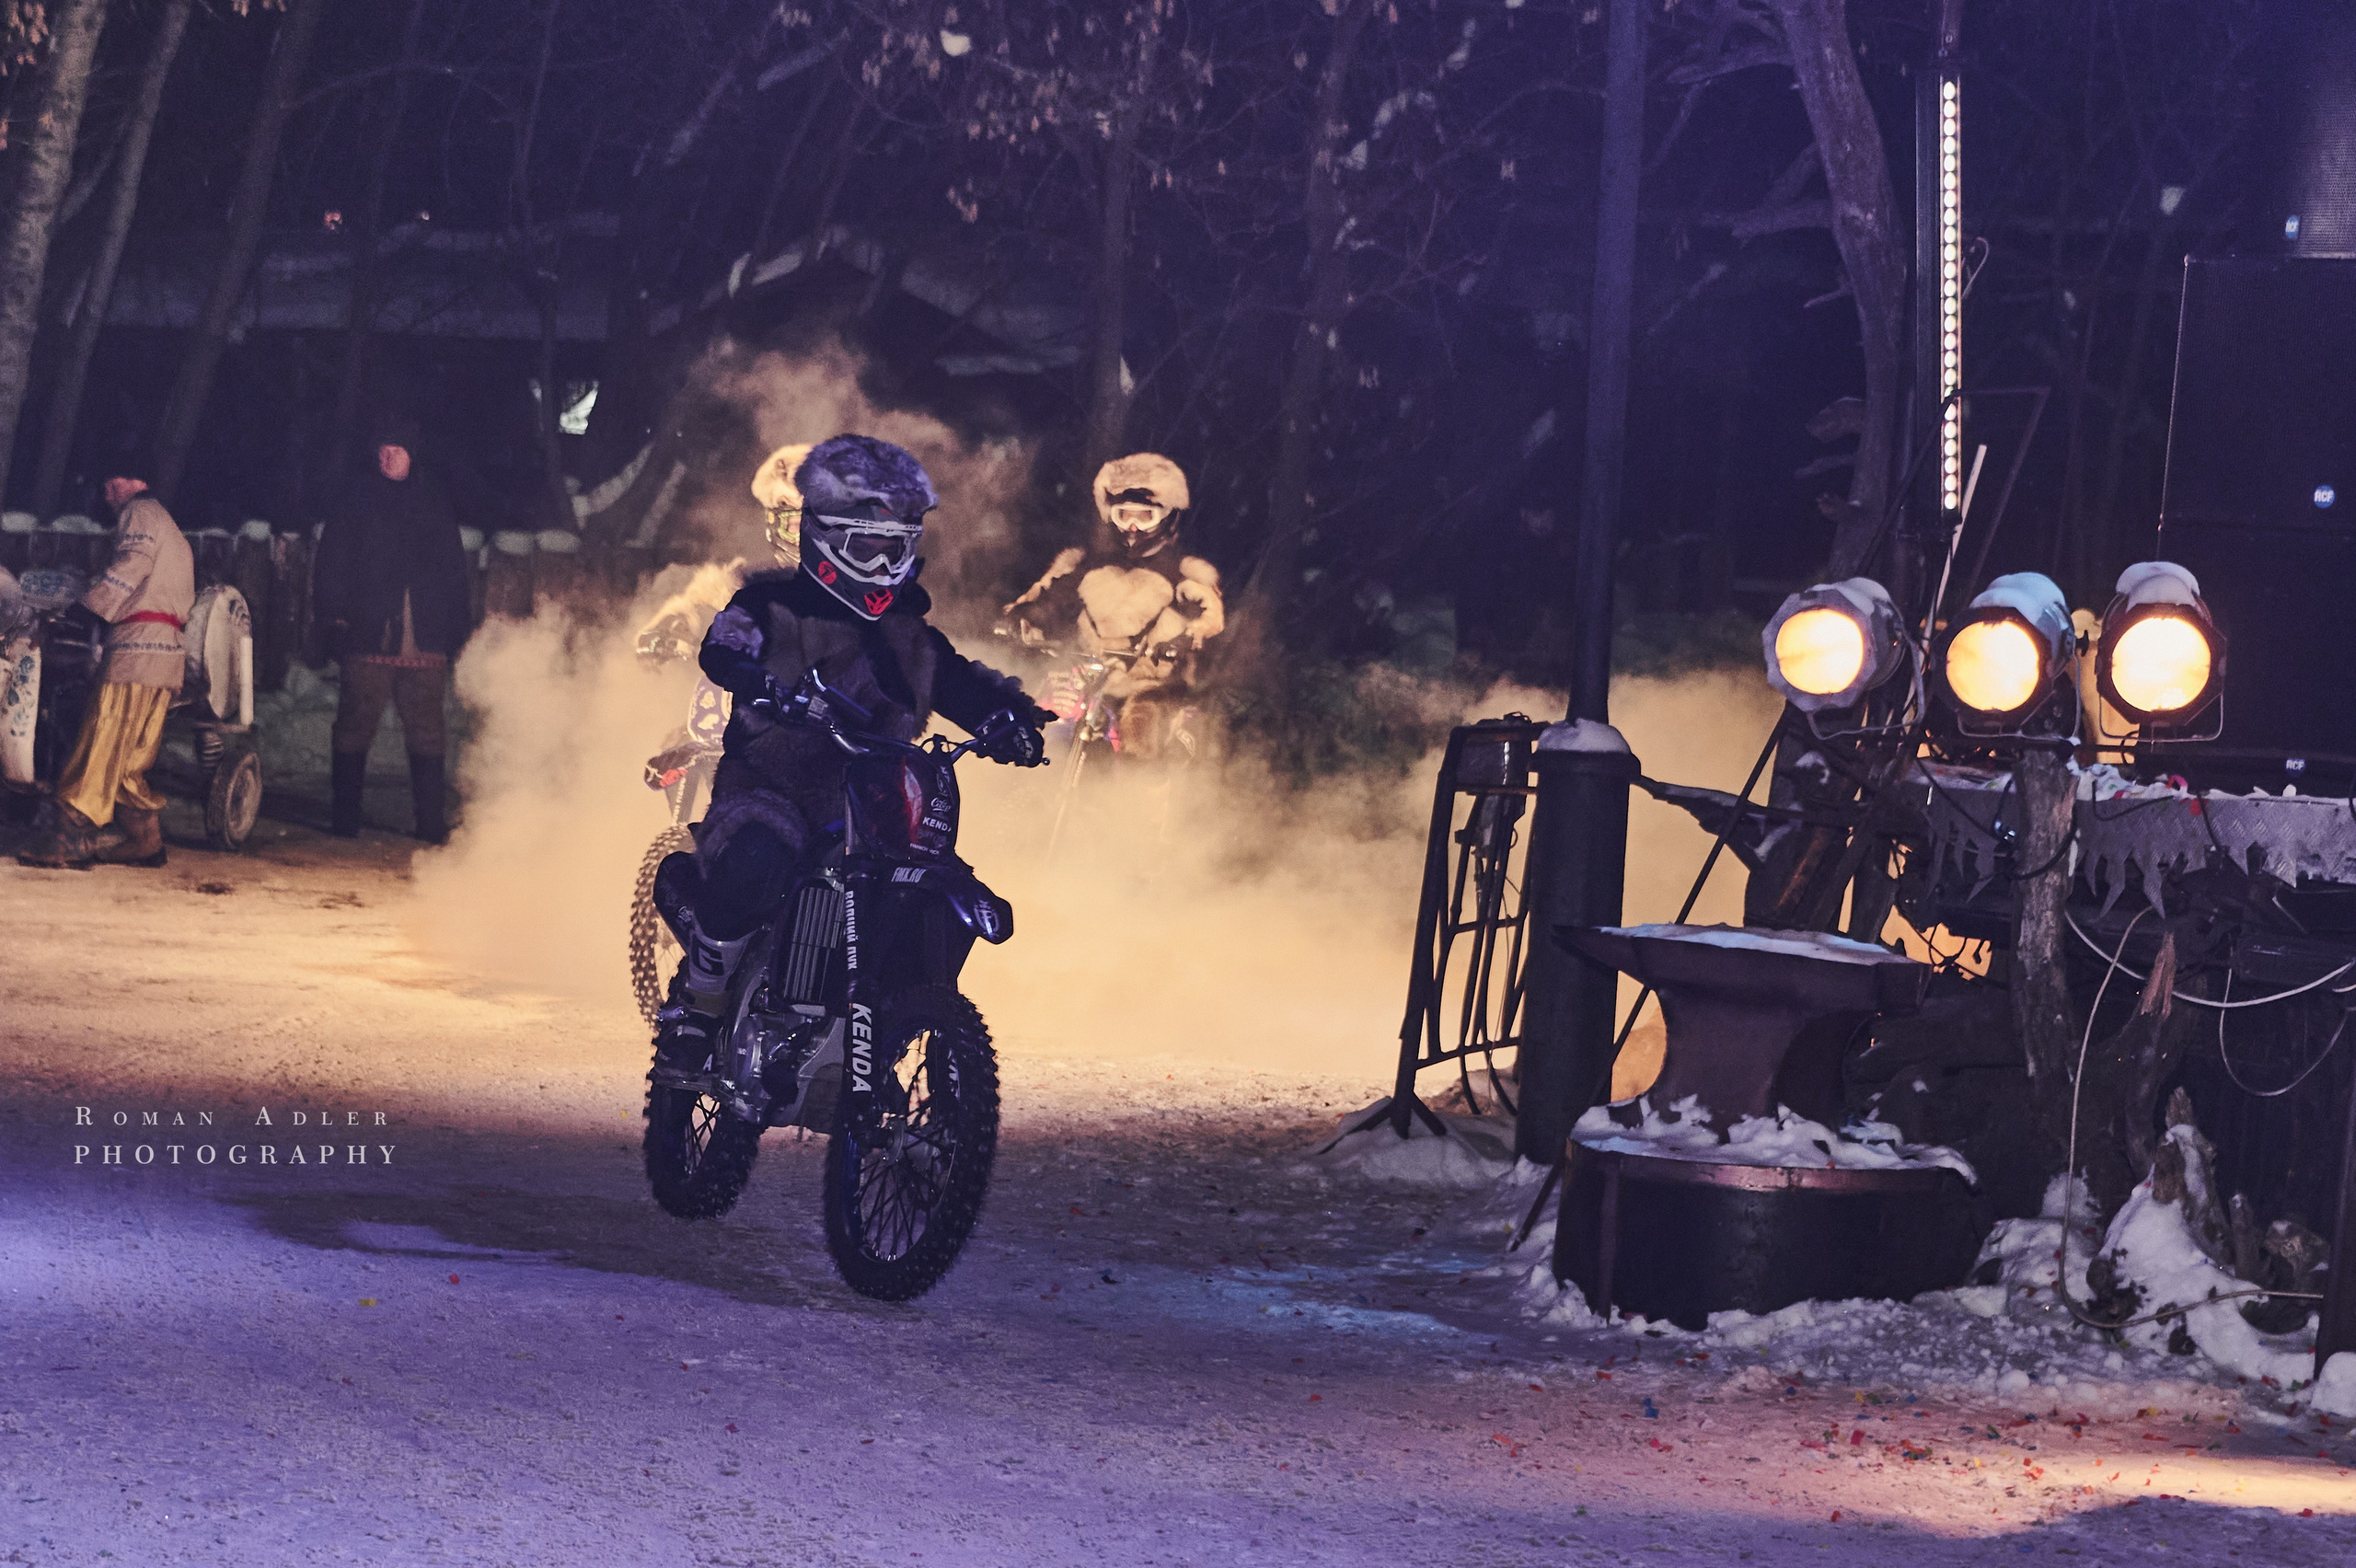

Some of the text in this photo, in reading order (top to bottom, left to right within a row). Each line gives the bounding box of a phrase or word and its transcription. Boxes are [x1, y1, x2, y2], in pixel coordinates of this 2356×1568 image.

[2314, 489, 2334, 502] RCF
[2285, 758, 2305, 771] RCF
[852, 1003, 872, 1092] KENDA
